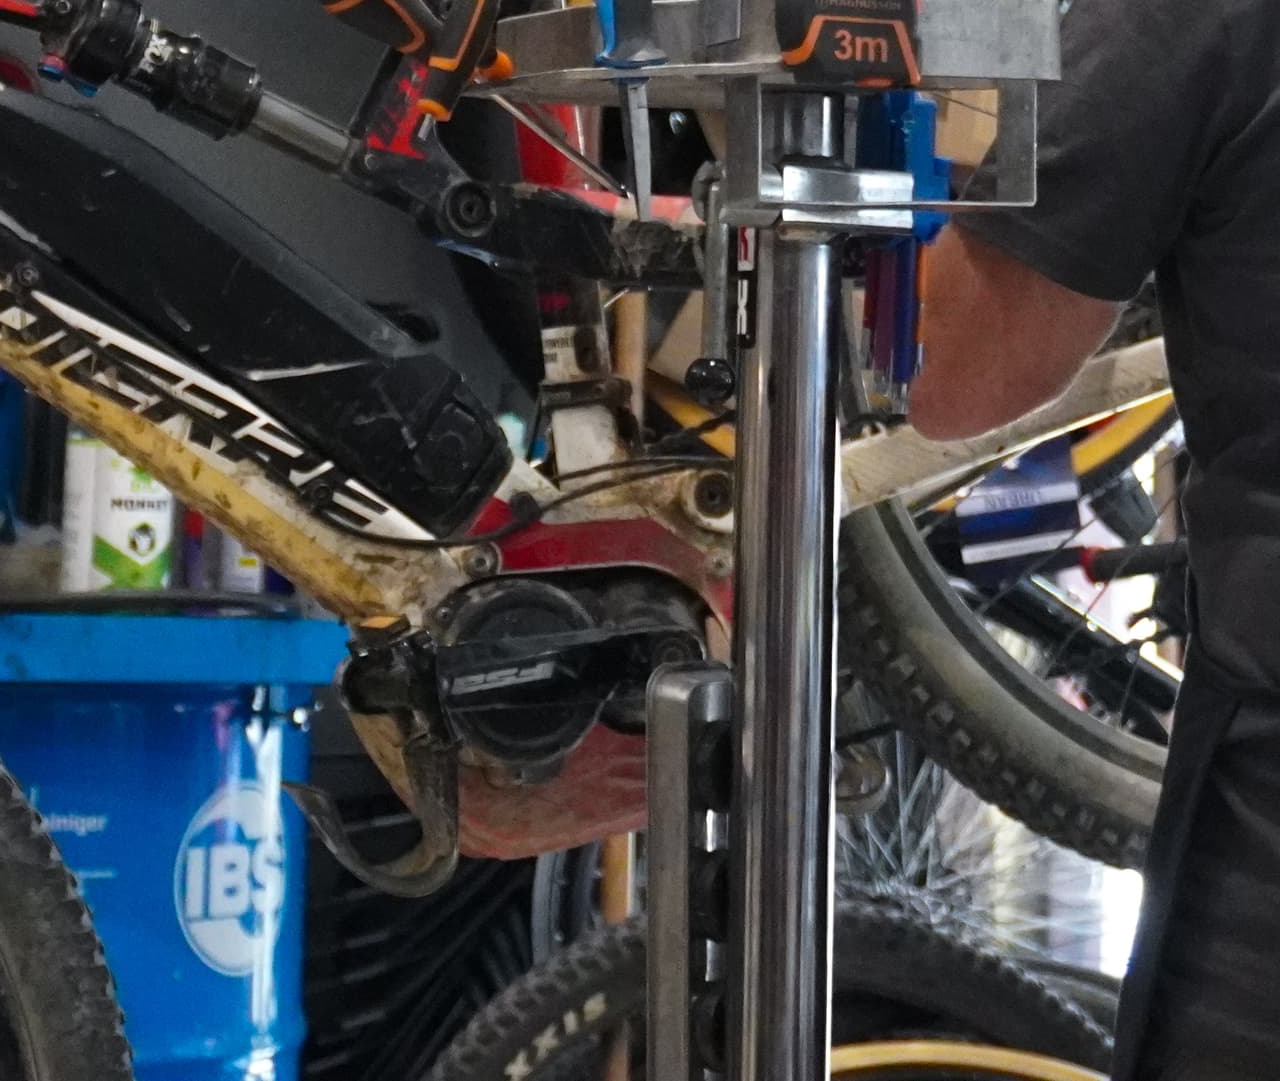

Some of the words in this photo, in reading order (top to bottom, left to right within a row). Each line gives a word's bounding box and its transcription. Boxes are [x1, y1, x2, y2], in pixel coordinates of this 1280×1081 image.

[834, 29, 889, 62] 3m
[184, 836, 284, 918] IBS
[504, 991, 607, 1081] XXIS
